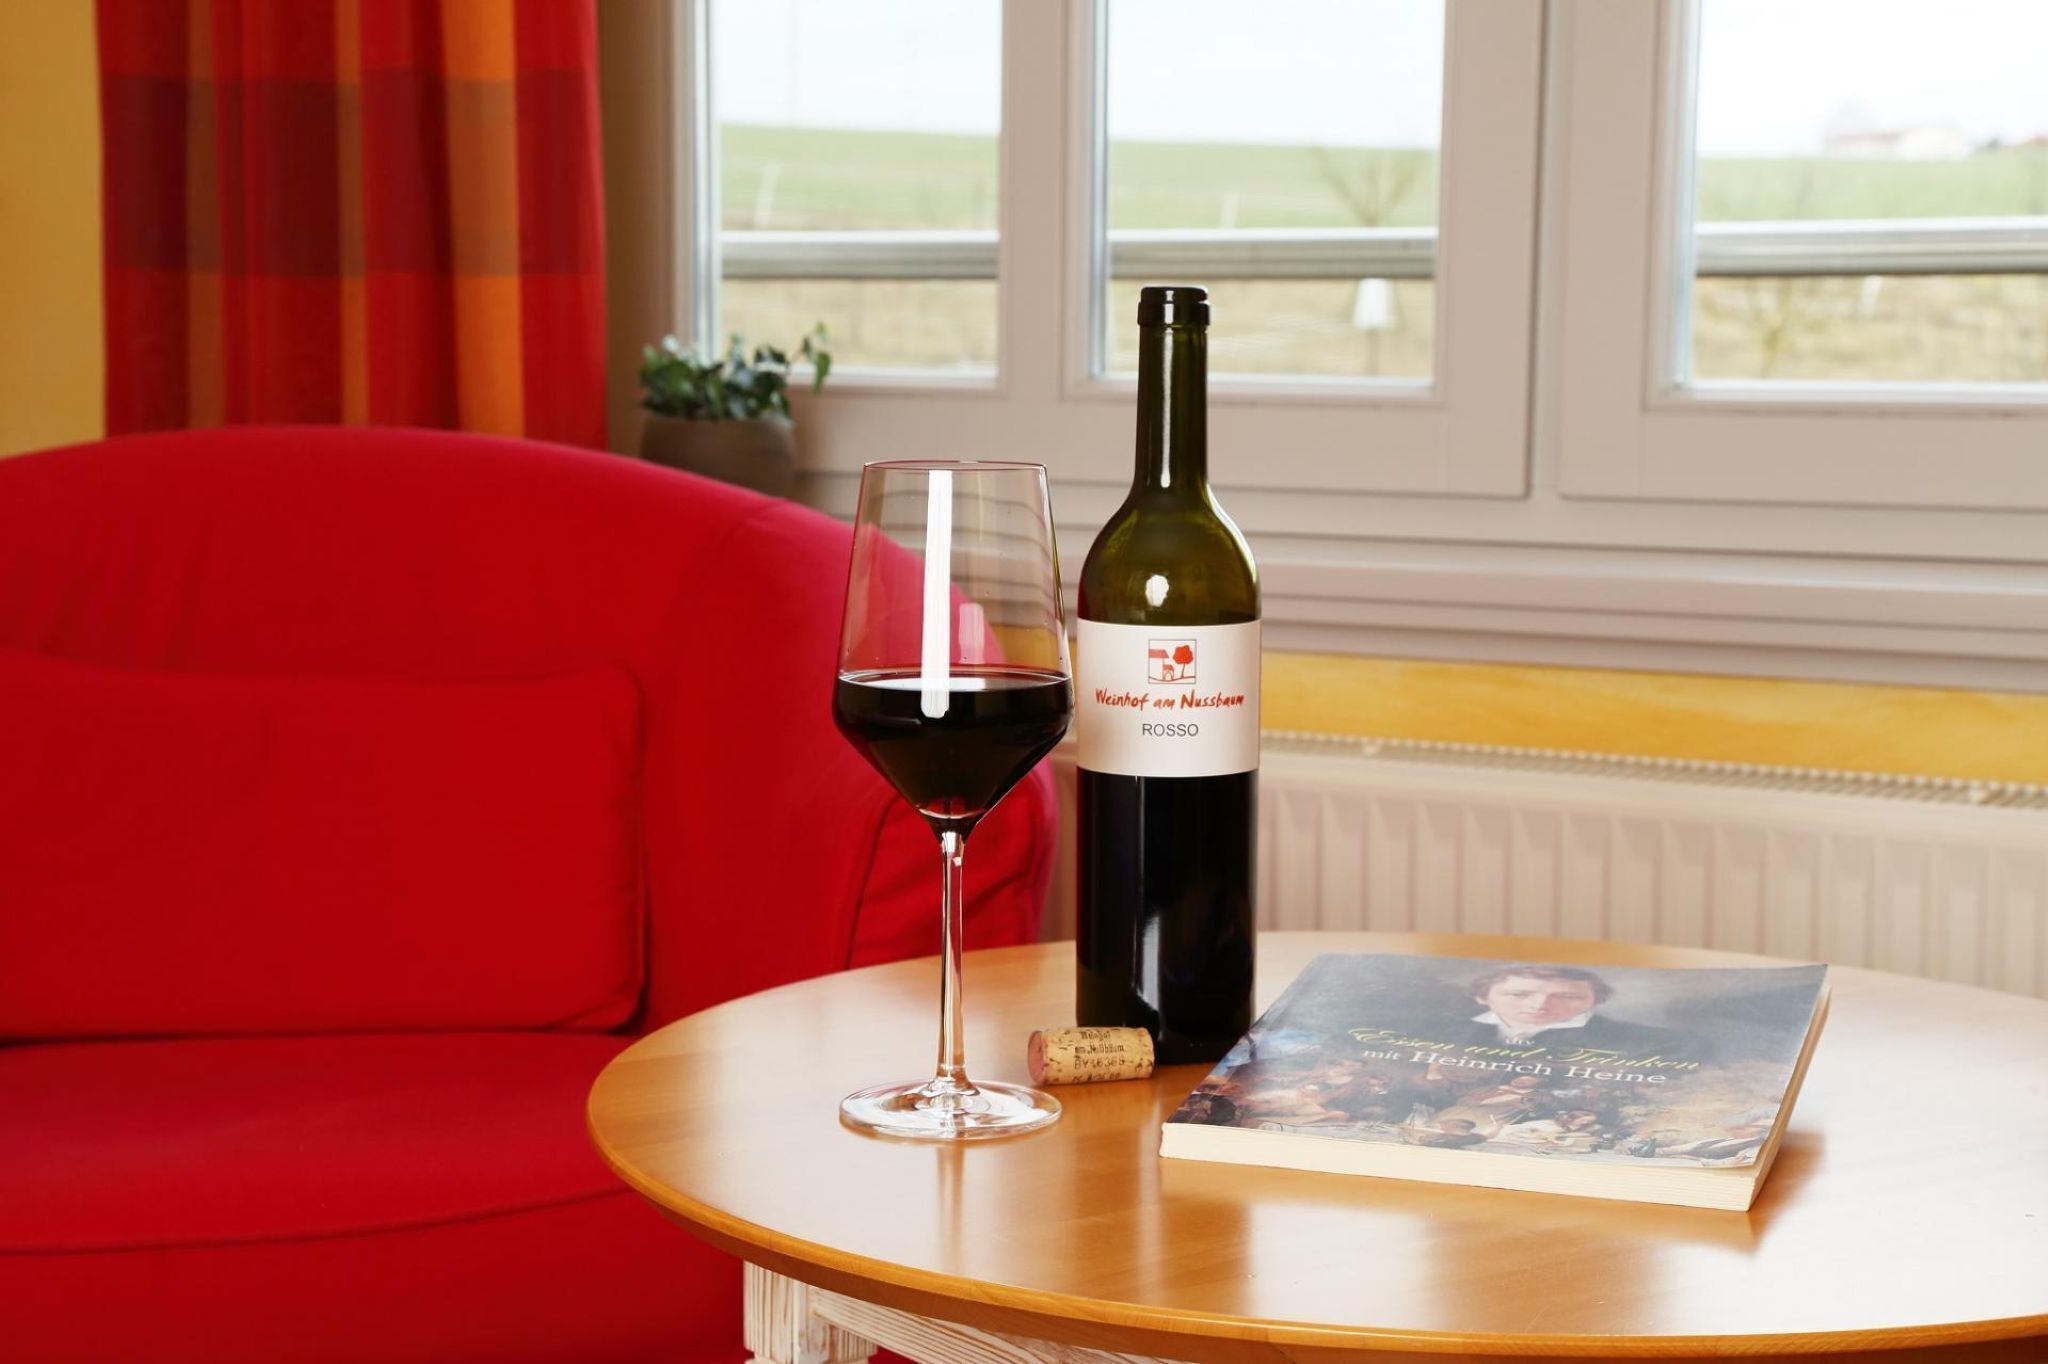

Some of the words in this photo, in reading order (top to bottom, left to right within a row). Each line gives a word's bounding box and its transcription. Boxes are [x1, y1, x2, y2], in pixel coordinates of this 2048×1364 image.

[1095, 688, 1149, 711] Weinhof
[1153, 696, 1175, 710] am
[1180, 689, 1245, 710] Nussbaum
[1142, 723, 1199, 737] ROSSO
[1362, 1049, 1401, 1061] mit
[1408, 1051, 1552, 1076] Heinrich
[1564, 1065, 1667, 1083] Heine
[1464, 1046, 1546, 1058] und
[1546, 1048, 1699, 1070] Trinken
